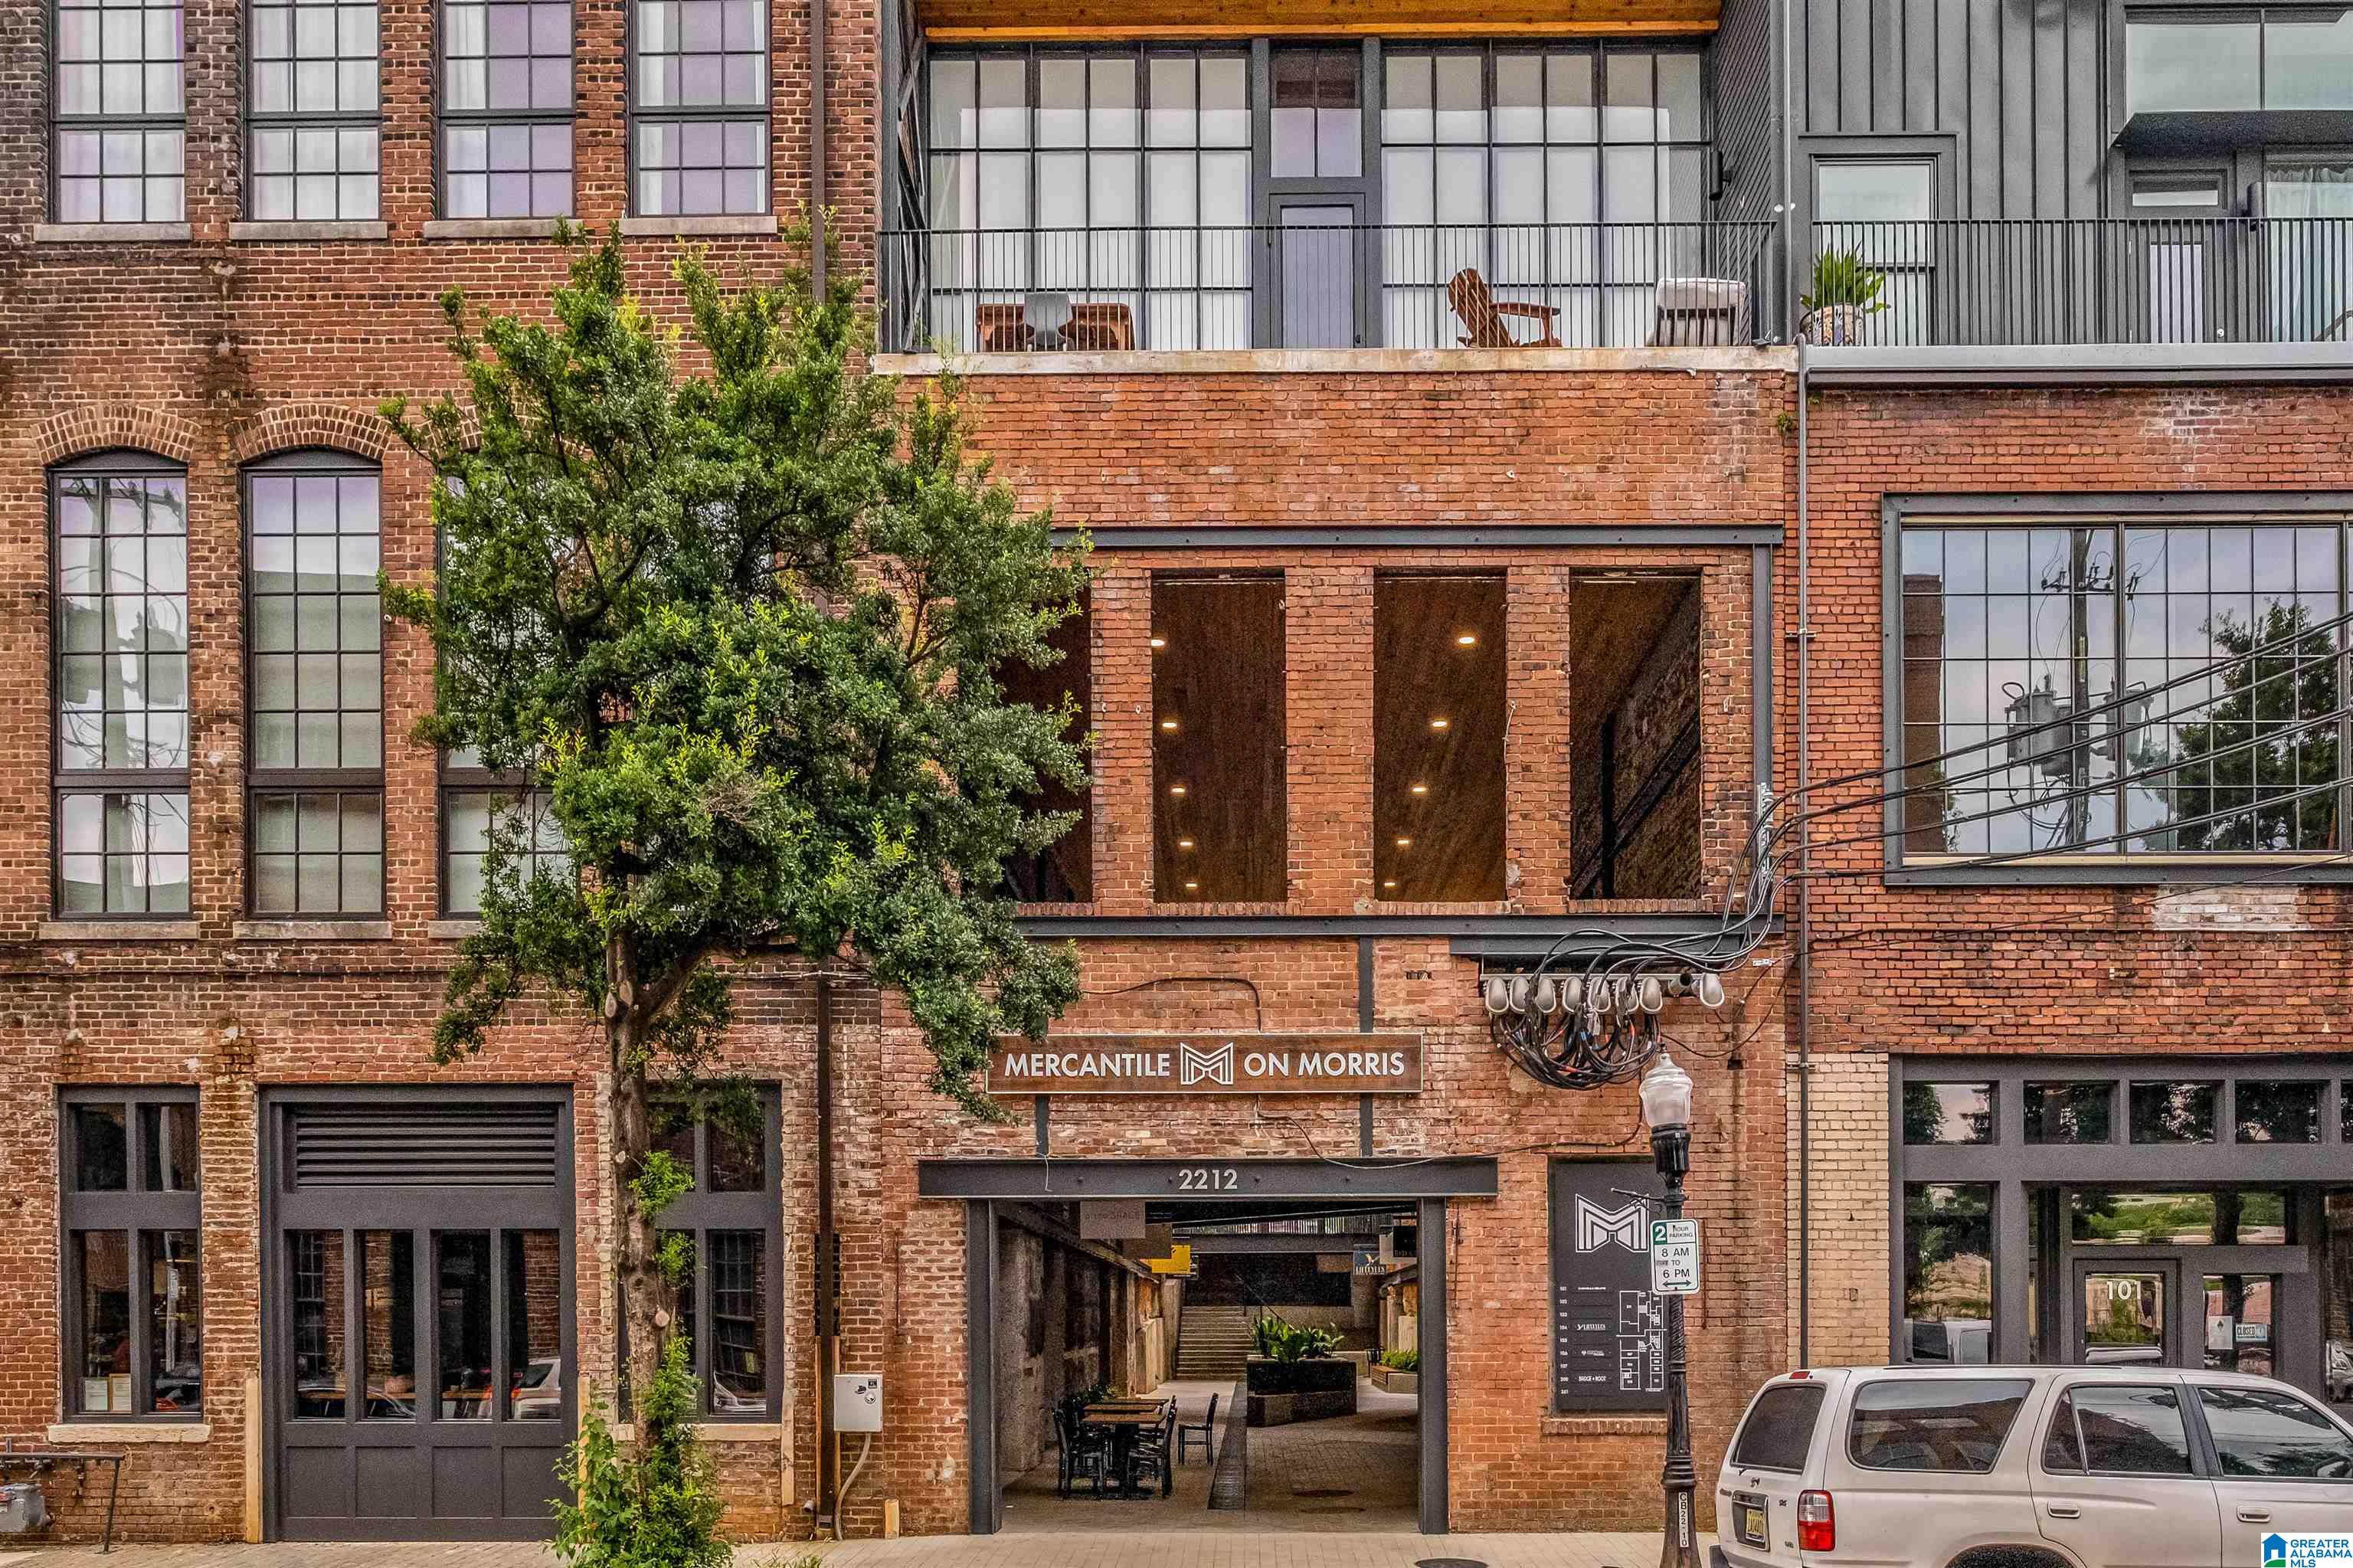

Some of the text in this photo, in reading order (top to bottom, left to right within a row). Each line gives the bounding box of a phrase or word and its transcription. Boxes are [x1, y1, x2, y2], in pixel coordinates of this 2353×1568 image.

[1004, 1053, 1170, 1077] MERCANTILE
[1244, 1052, 1289, 1076] ON
[1298, 1052, 1405, 1076] MORRIS
[1178, 1169, 1238, 1190] 2212
[1654, 1225, 1667, 1241] 2
[1661, 1247, 1690, 1257] 8 AM
[1663, 1268, 1690, 1278] 6 PM
[2107, 1280, 2142, 1300] 101
[2237, 1326, 2256, 1336] CLOSED
